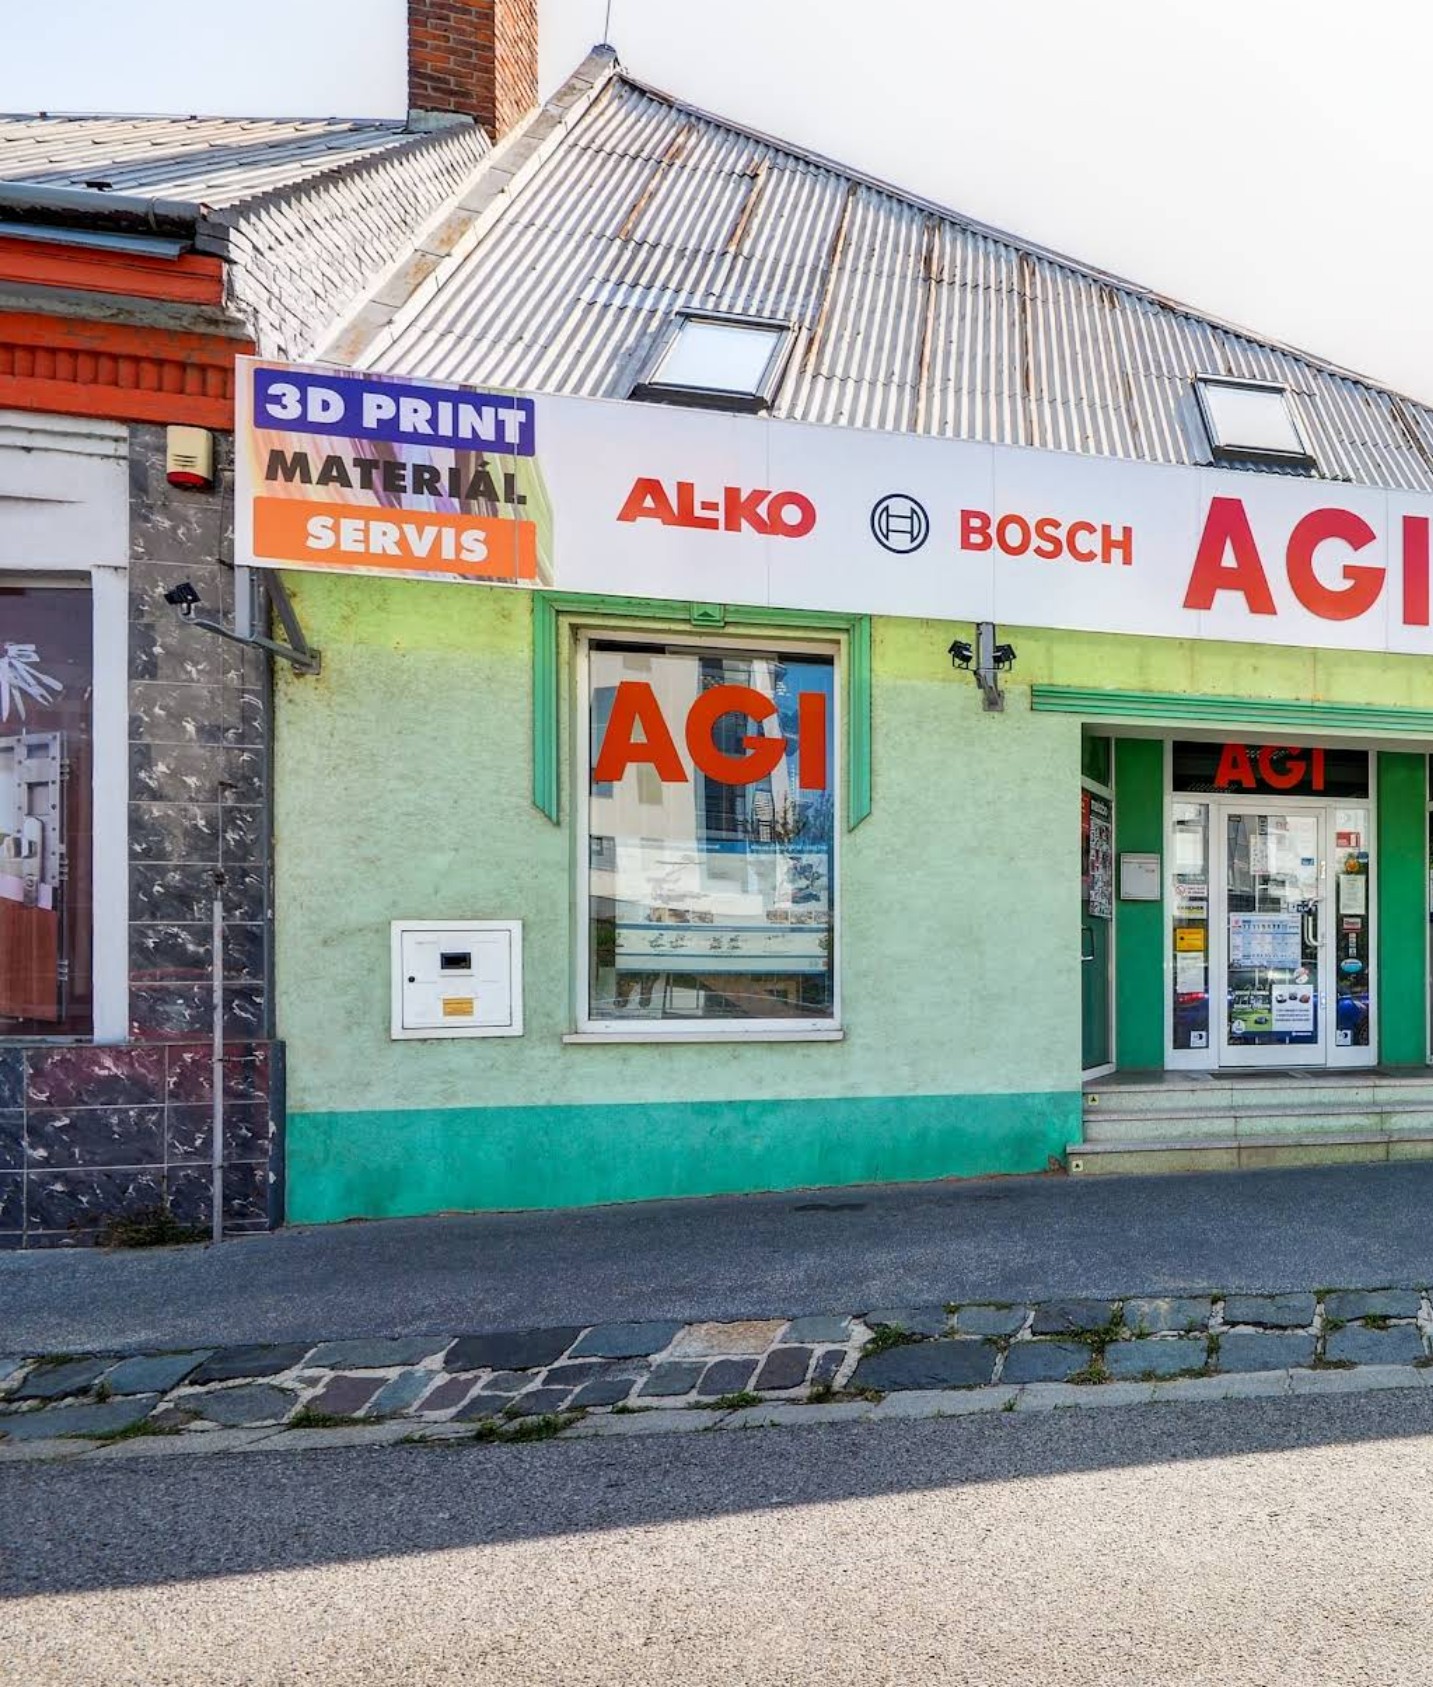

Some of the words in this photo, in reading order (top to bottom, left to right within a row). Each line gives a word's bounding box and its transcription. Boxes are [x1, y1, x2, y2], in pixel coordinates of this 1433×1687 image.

[265, 383, 345, 424] 3D
[362, 392, 526, 444] PRINT
[265, 449, 528, 505] MATERIÁL
[616, 477, 817, 537] AL-KO
[305, 515, 488, 562] SERVIS
[960, 508, 1133, 566] BOSCH
[1183, 496, 1429, 626] AGI
[593, 681, 827, 790] AGI
[1215, 743, 1324, 791] AGI
